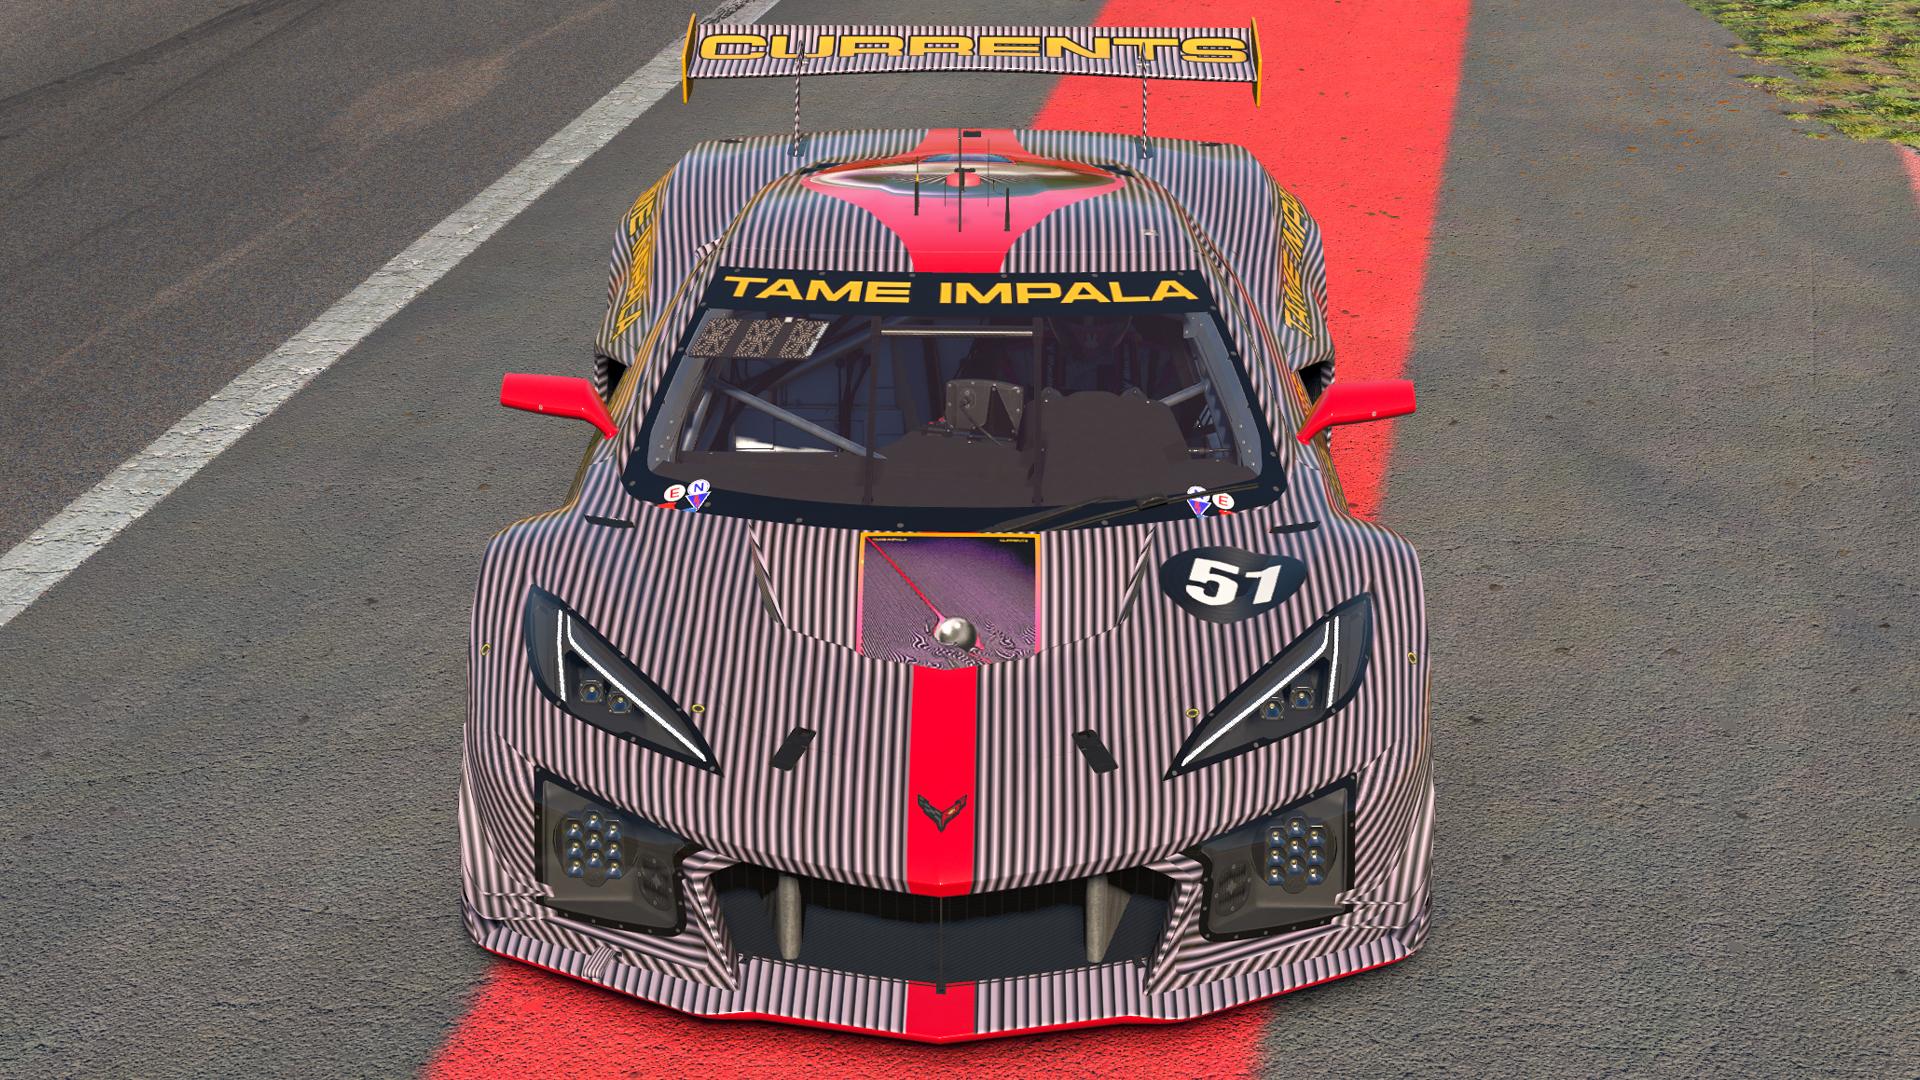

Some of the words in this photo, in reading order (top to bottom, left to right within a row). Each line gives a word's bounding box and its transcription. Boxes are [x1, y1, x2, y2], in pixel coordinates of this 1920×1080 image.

[699, 34, 1248, 63] CURRENTS
[723, 275, 911, 304] TAME
[939, 279, 1200, 304] IMPALA
[670, 487, 680, 498] E
[693, 482, 704, 492] N
[1218, 496, 1228, 506] E
[1185, 557, 1282, 606] 51
